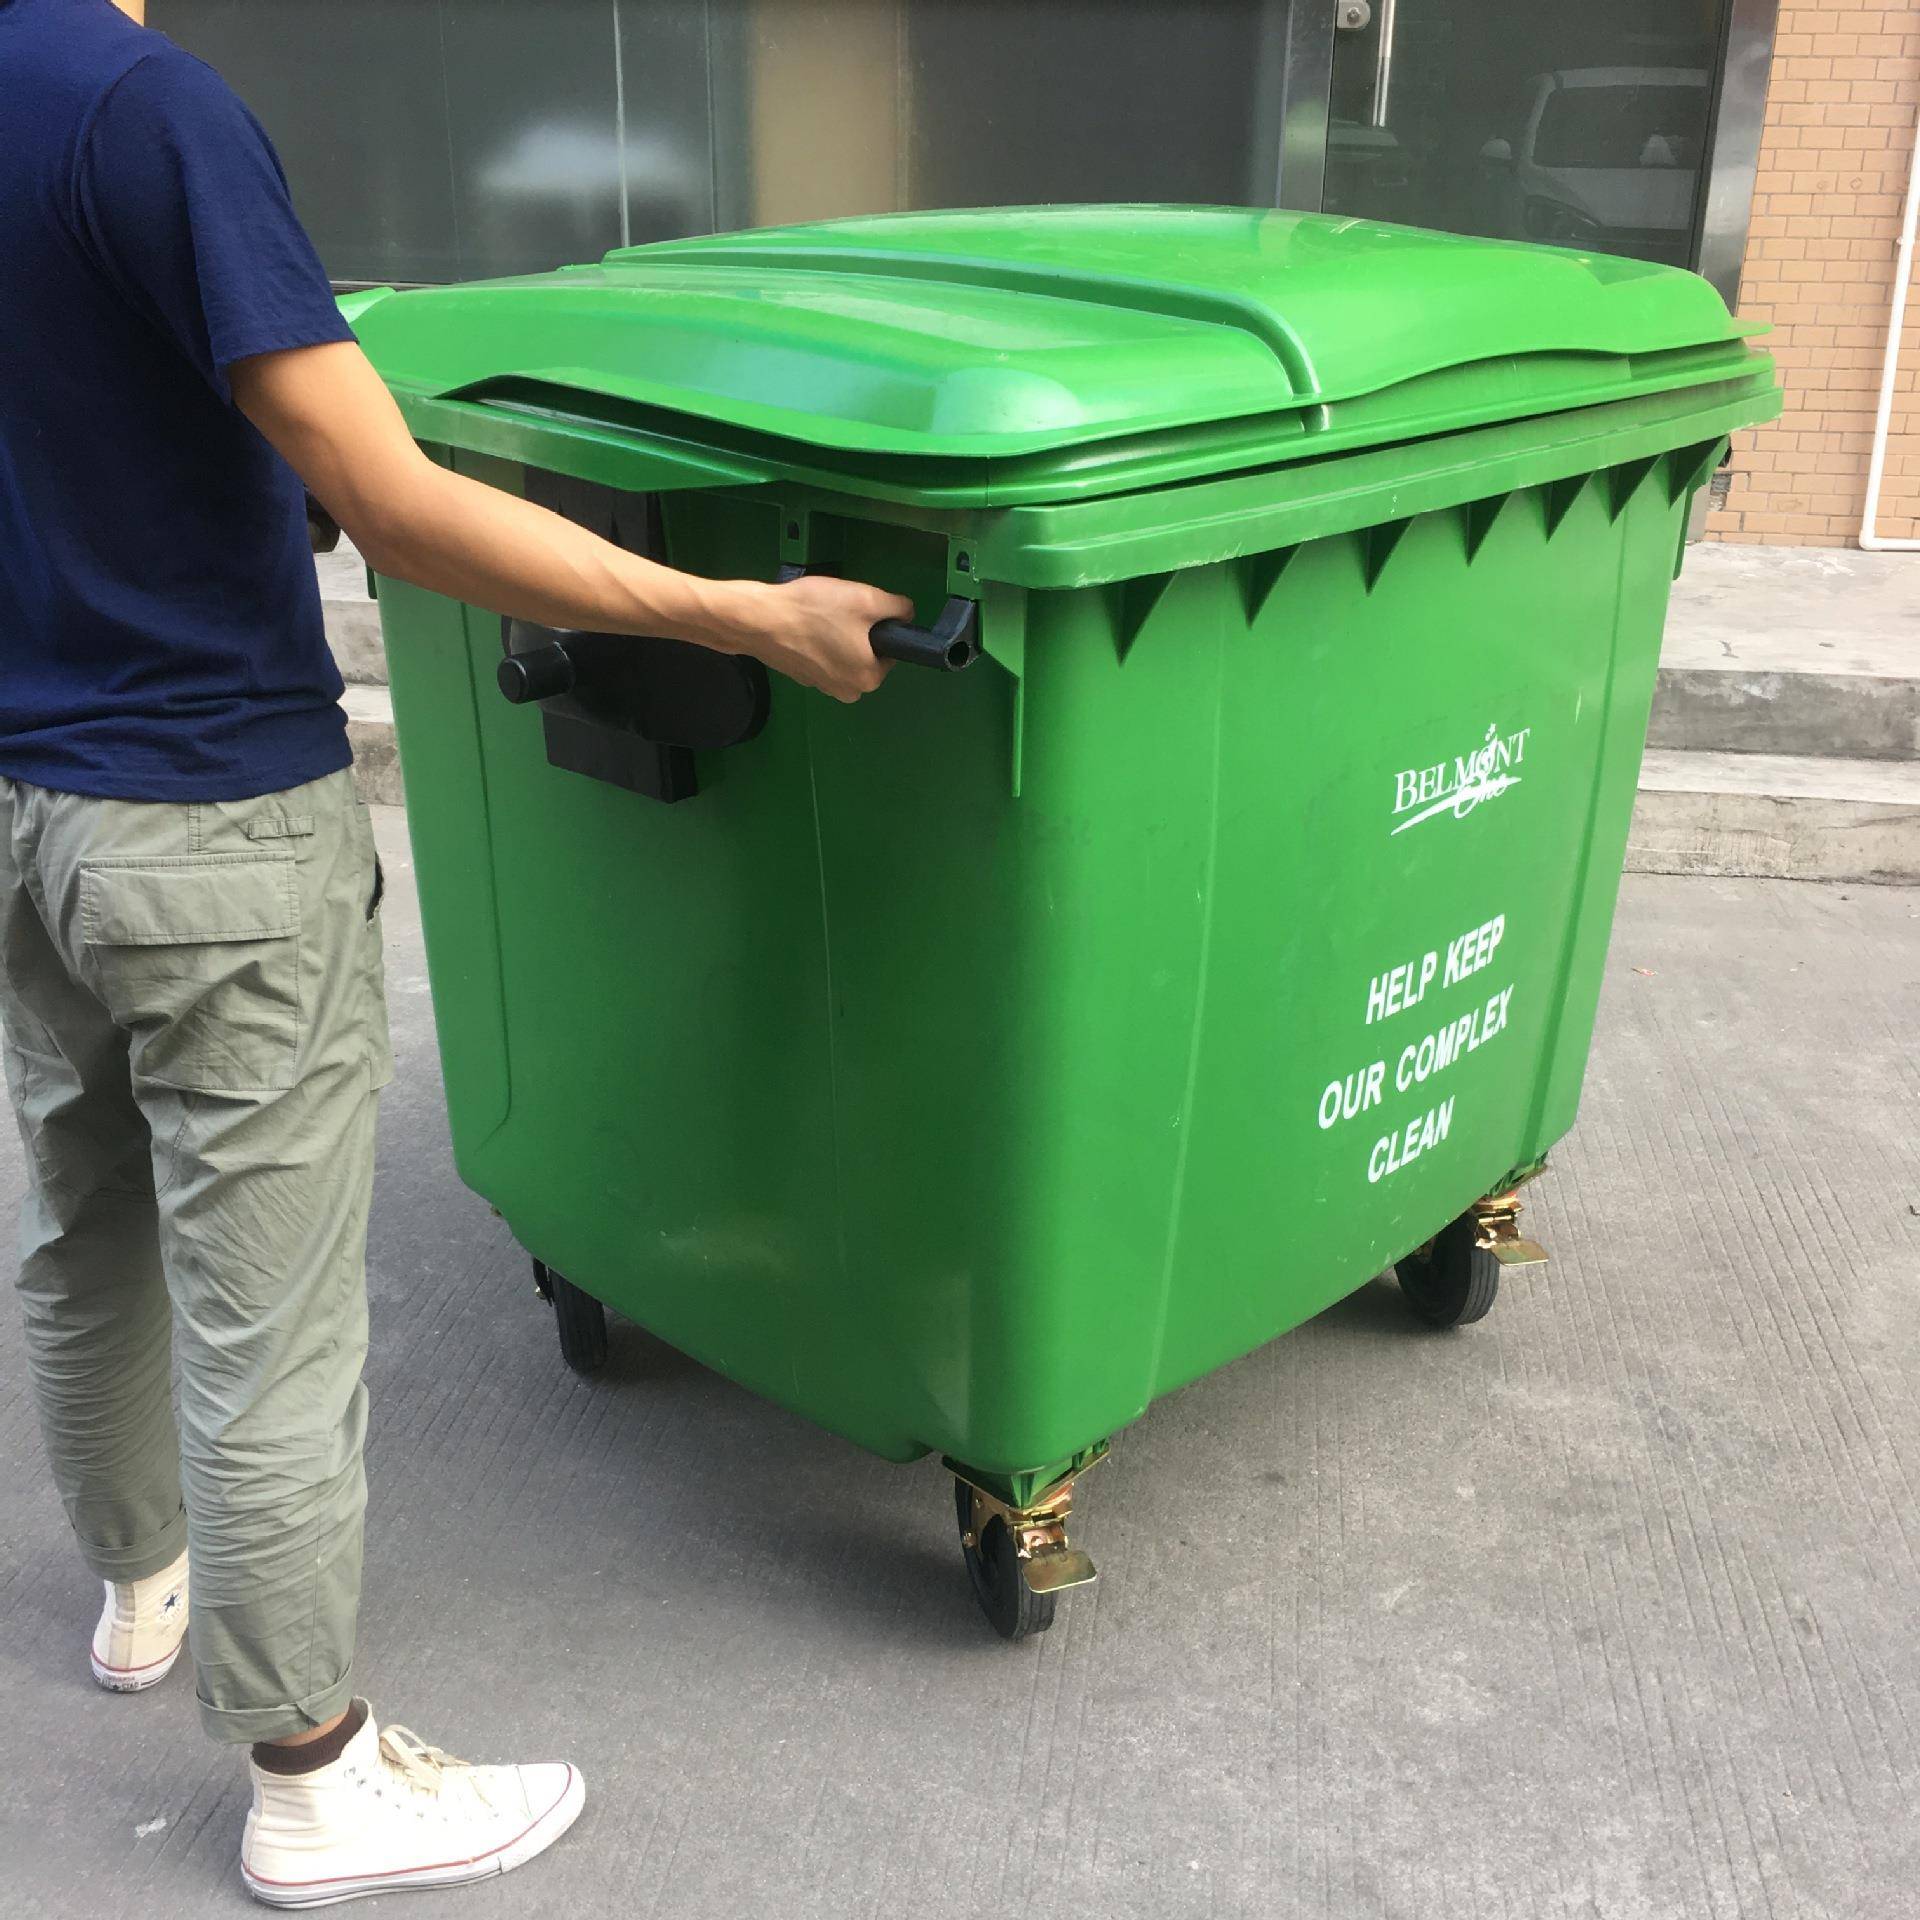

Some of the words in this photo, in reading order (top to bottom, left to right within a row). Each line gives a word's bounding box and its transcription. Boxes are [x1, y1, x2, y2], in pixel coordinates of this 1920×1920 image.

[1391, 727, 1531, 814] BELMONT
[1366, 951, 1438, 1025] HELP
[1443, 914, 1506, 989] KEEP
[1318, 1060, 1386, 1130] OUR
[1396, 984, 1514, 1093] COMPLEX
[1367, 1095, 1455, 1184] CLEAN
